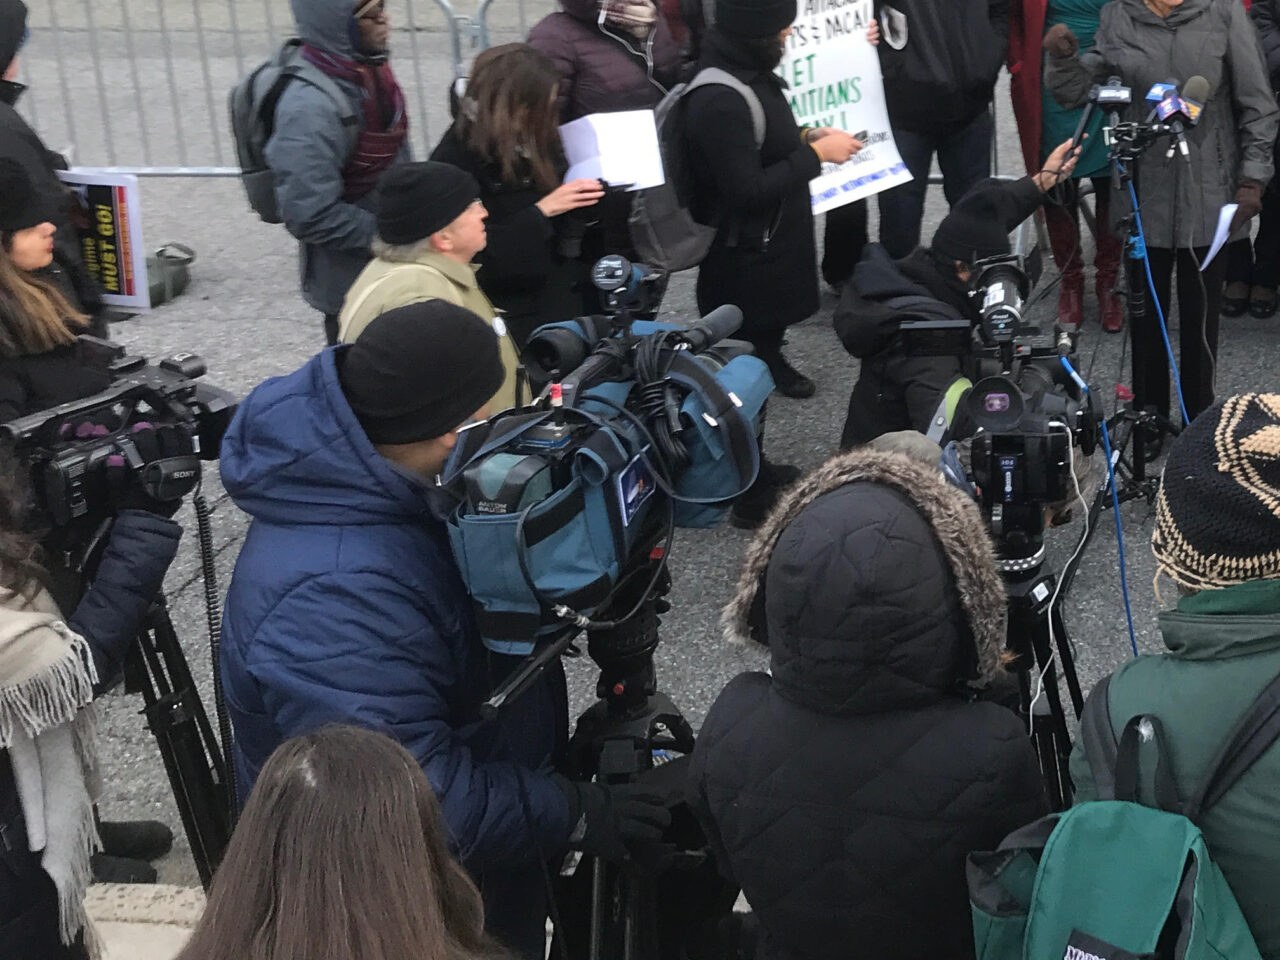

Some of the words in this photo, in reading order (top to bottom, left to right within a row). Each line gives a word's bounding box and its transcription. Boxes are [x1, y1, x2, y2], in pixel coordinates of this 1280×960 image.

[789, 75, 863, 119] AITIANS
[98, 240, 120, 291] MUST
[174, 470, 196, 479] SONY
